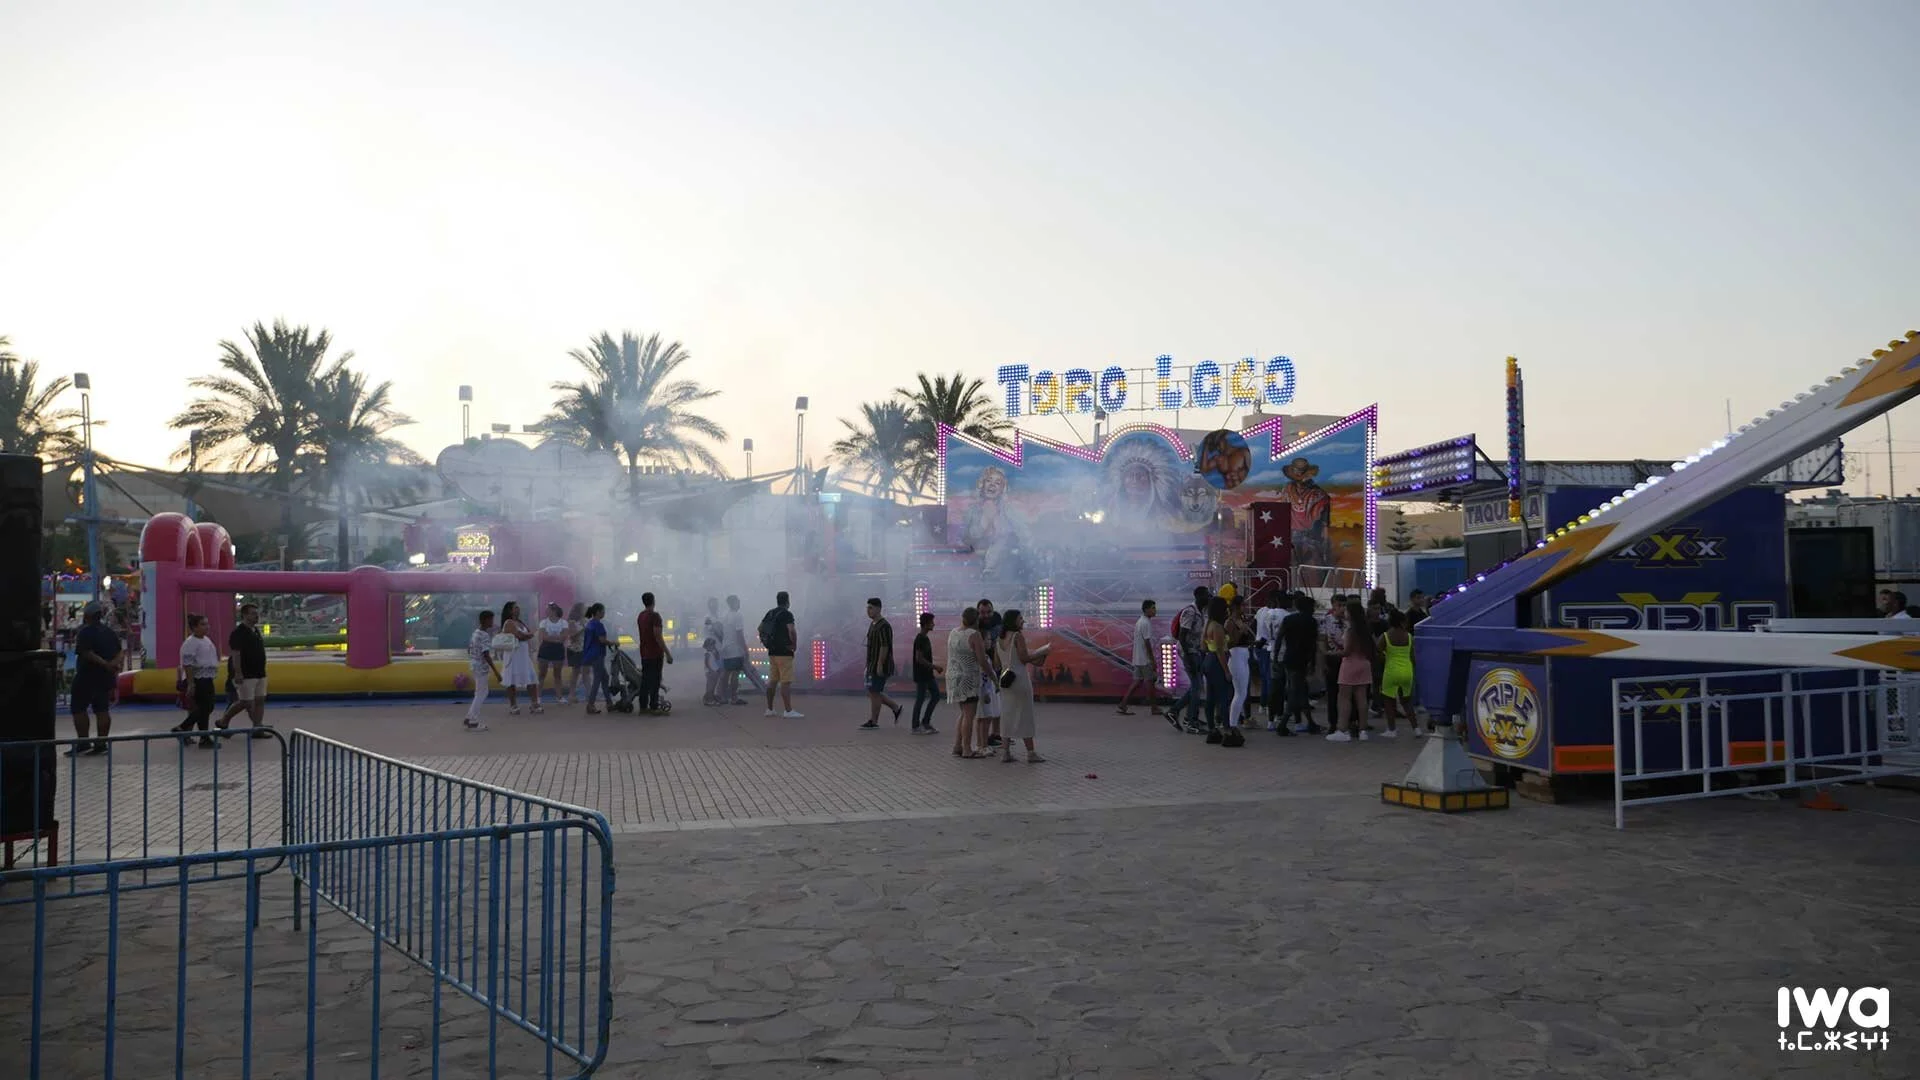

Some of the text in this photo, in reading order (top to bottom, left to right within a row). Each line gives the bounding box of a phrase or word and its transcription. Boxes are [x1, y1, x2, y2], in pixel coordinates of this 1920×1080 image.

[998, 354, 1297, 417] TORO LOCO
[1479, 682, 1534, 720] TRIPLE
